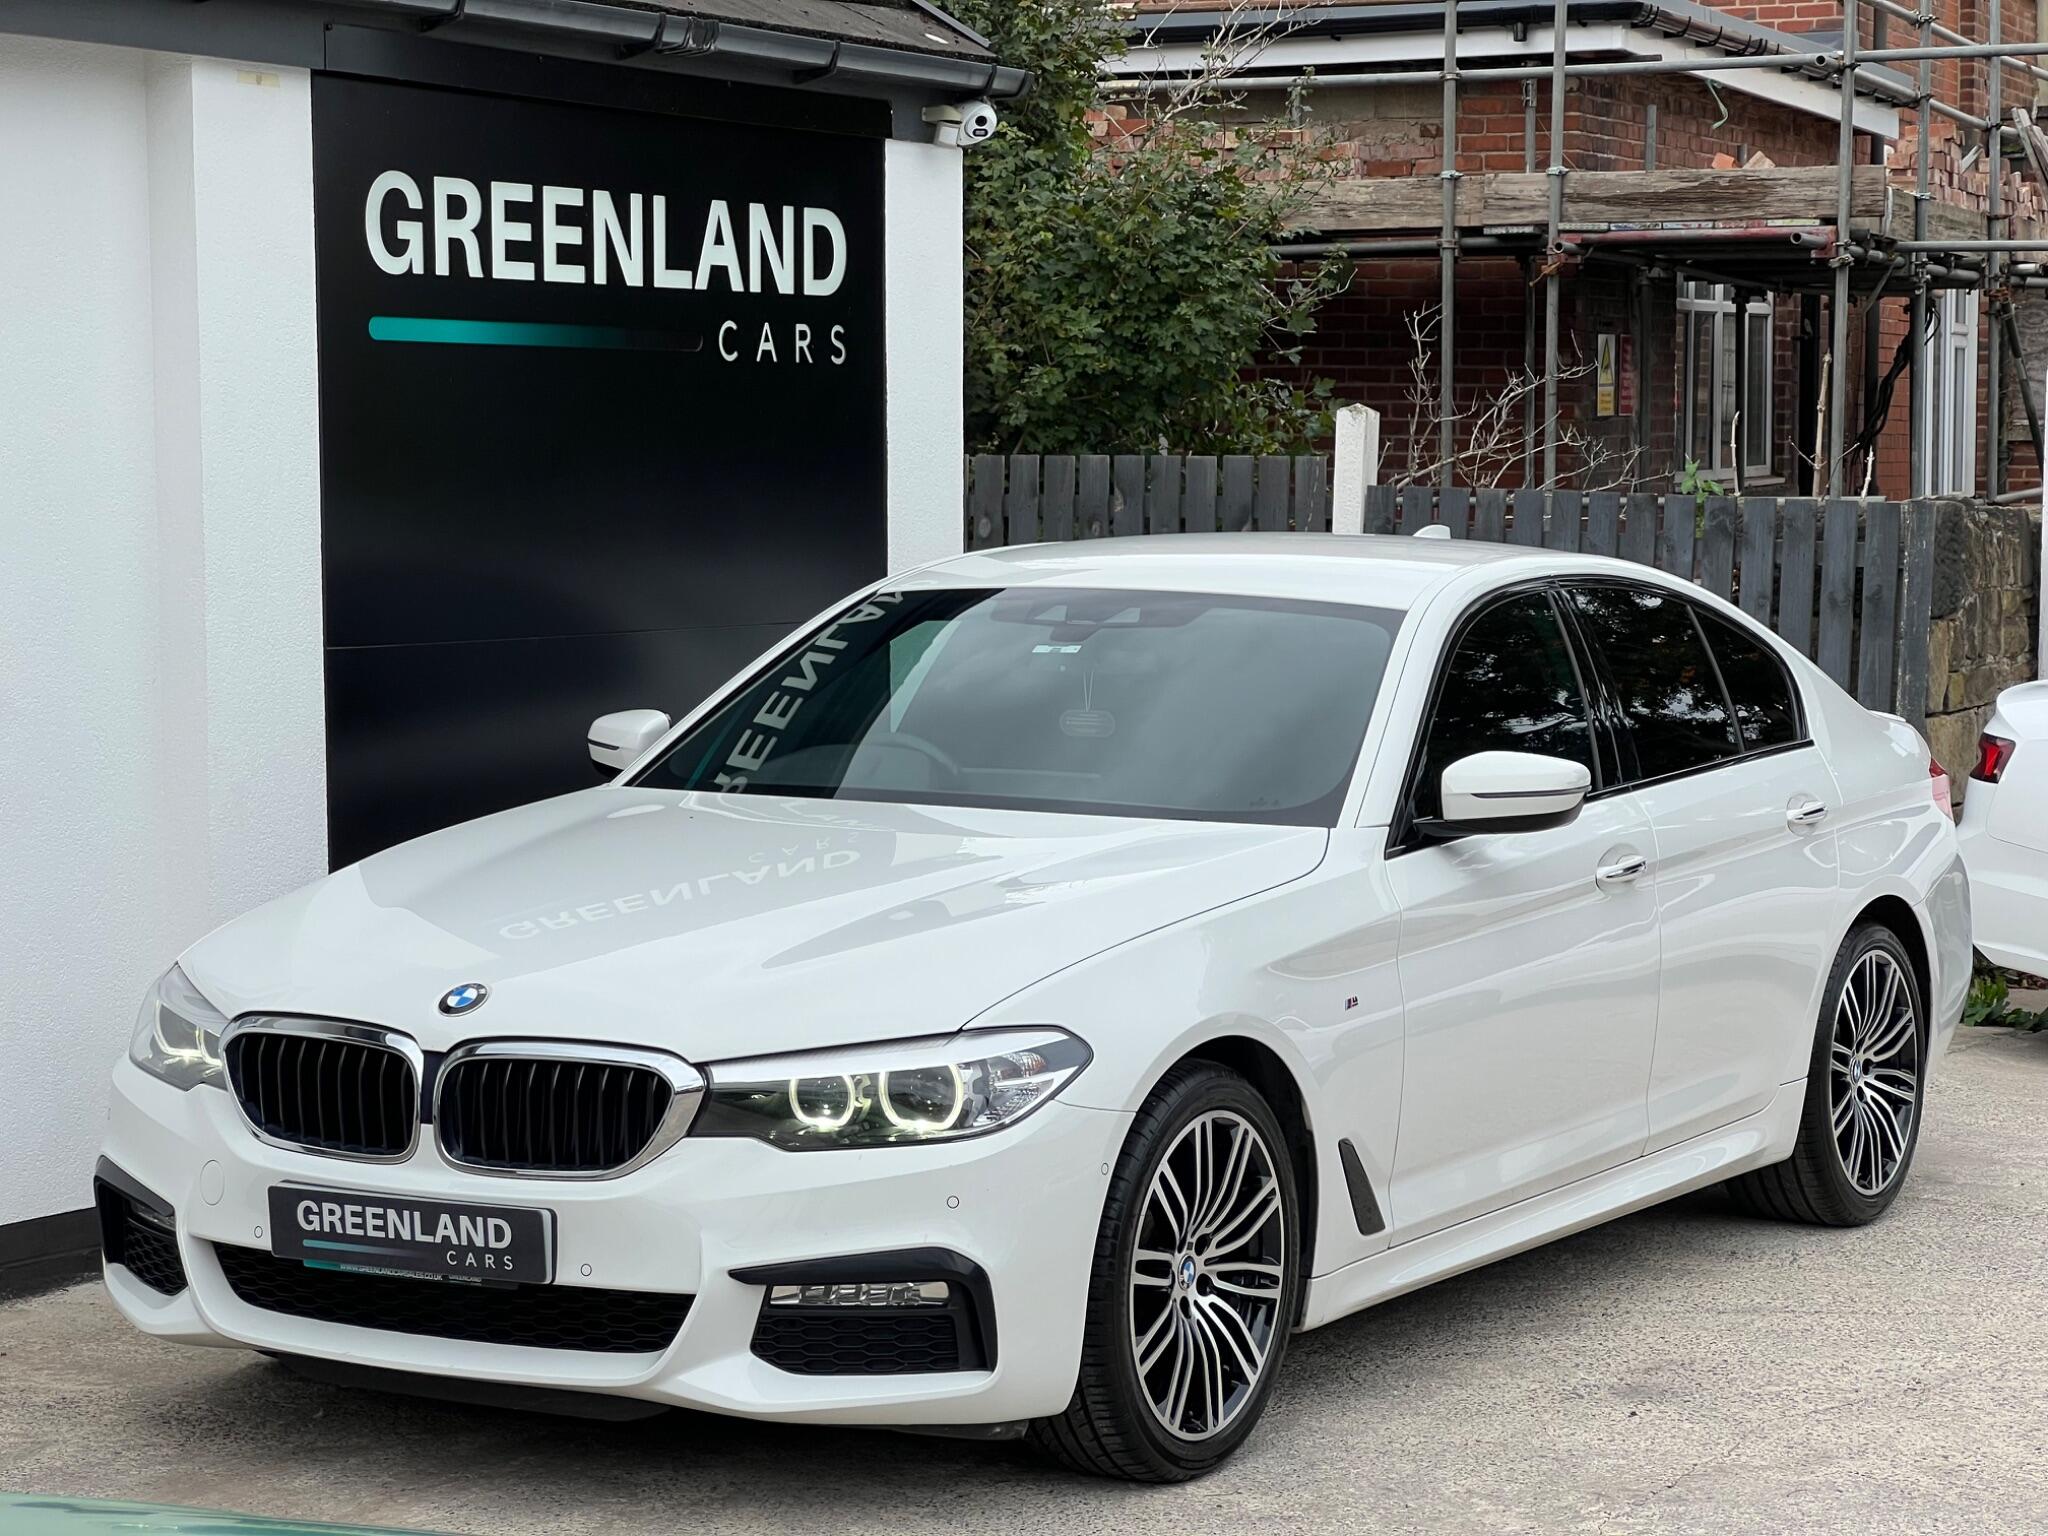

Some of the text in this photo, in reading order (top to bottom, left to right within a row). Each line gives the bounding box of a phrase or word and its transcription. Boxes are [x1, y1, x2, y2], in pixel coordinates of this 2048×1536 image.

[365, 170, 847, 296] GREENLAND
[718, 320, 847, 365] CARS
[296, 1200, 512, 1249] GREENLAND
[446, 1250, 514, 1271] CARS
